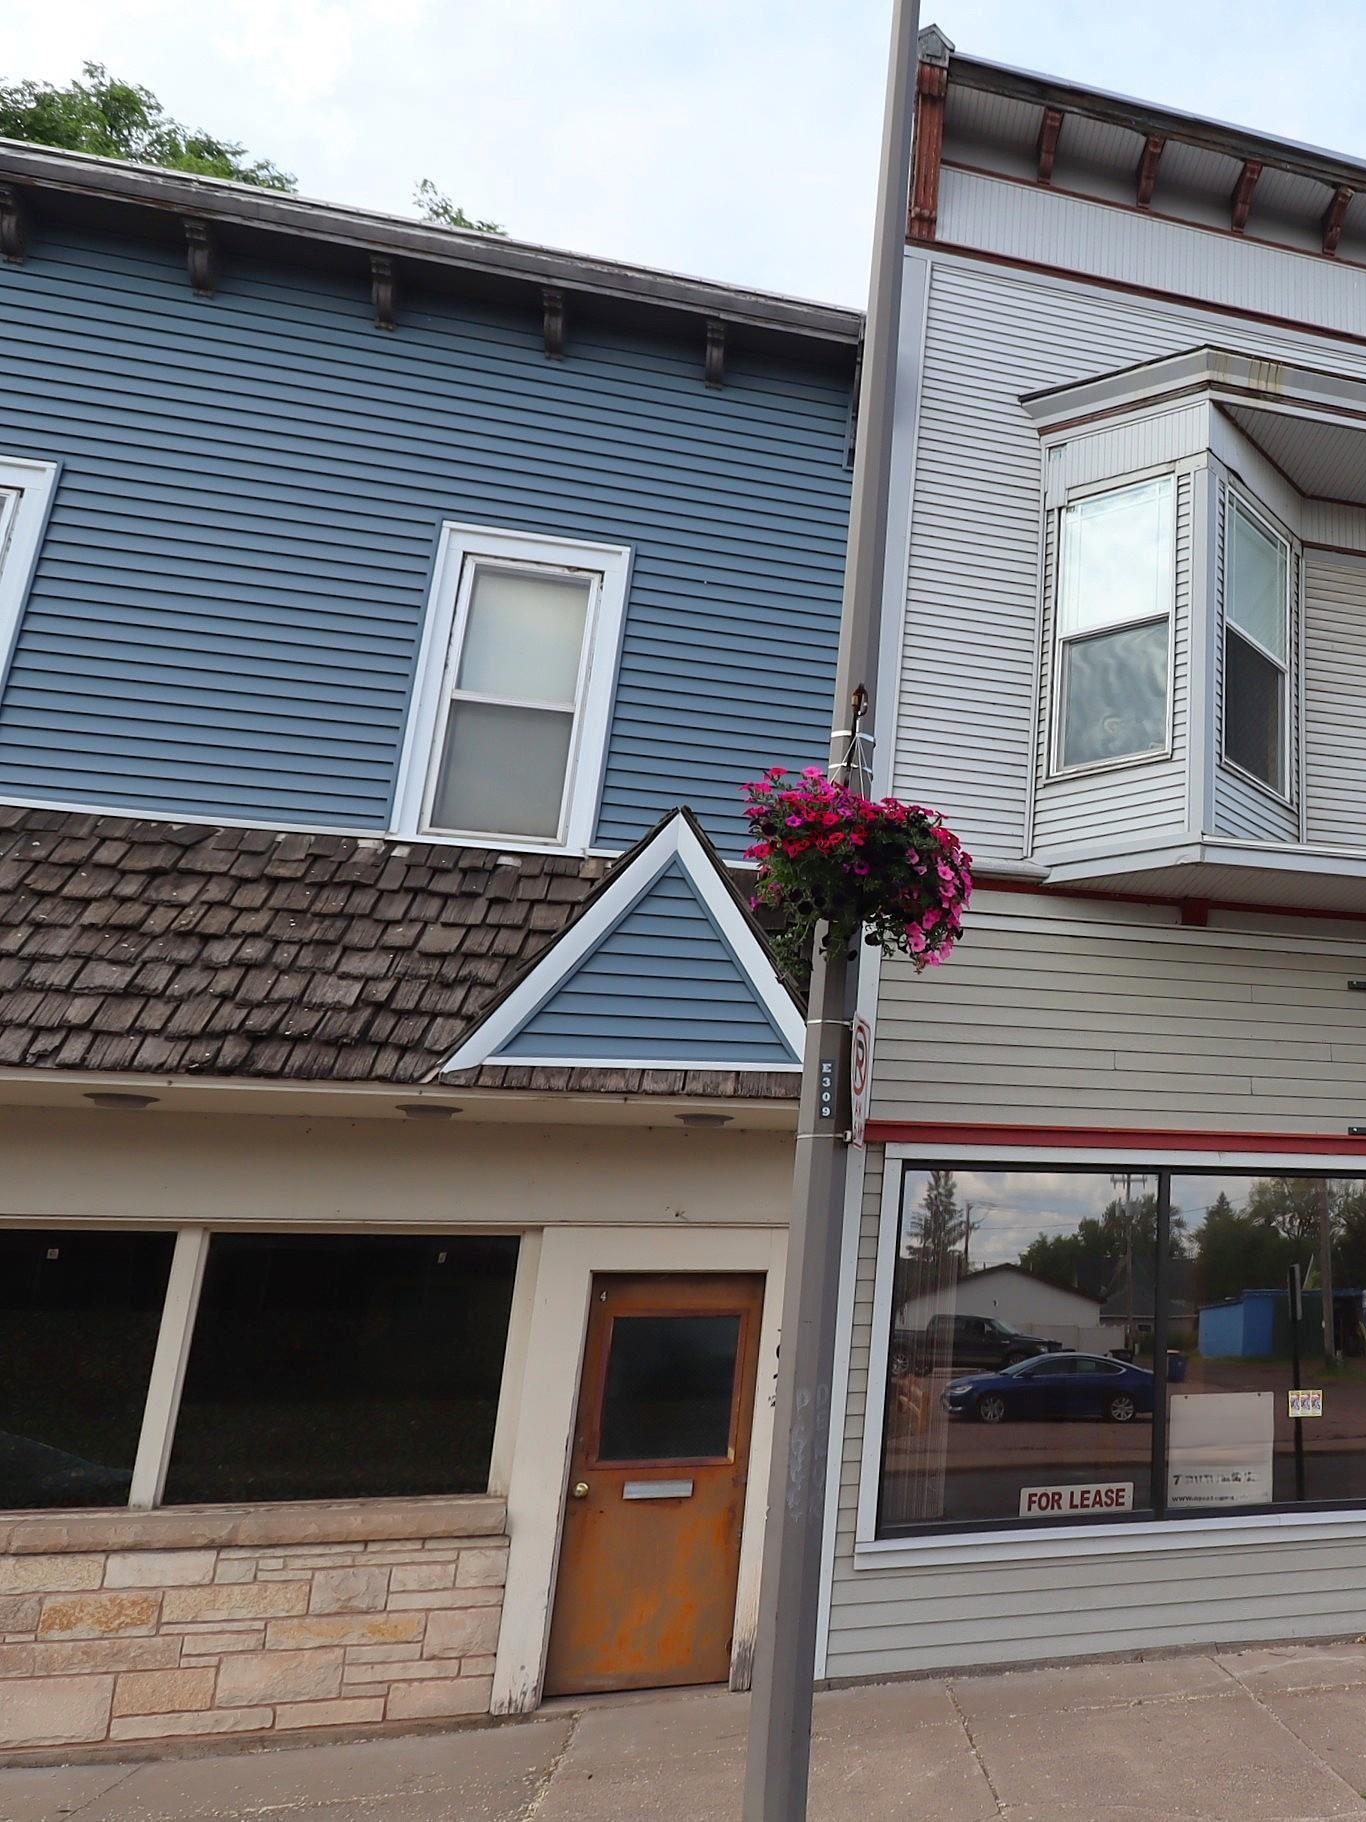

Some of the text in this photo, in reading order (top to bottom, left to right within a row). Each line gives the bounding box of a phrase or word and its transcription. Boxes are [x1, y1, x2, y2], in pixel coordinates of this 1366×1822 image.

[821, 1063, 832, 1117] E309
[1027, 1488, 1126, 1511] FOR LEASE
